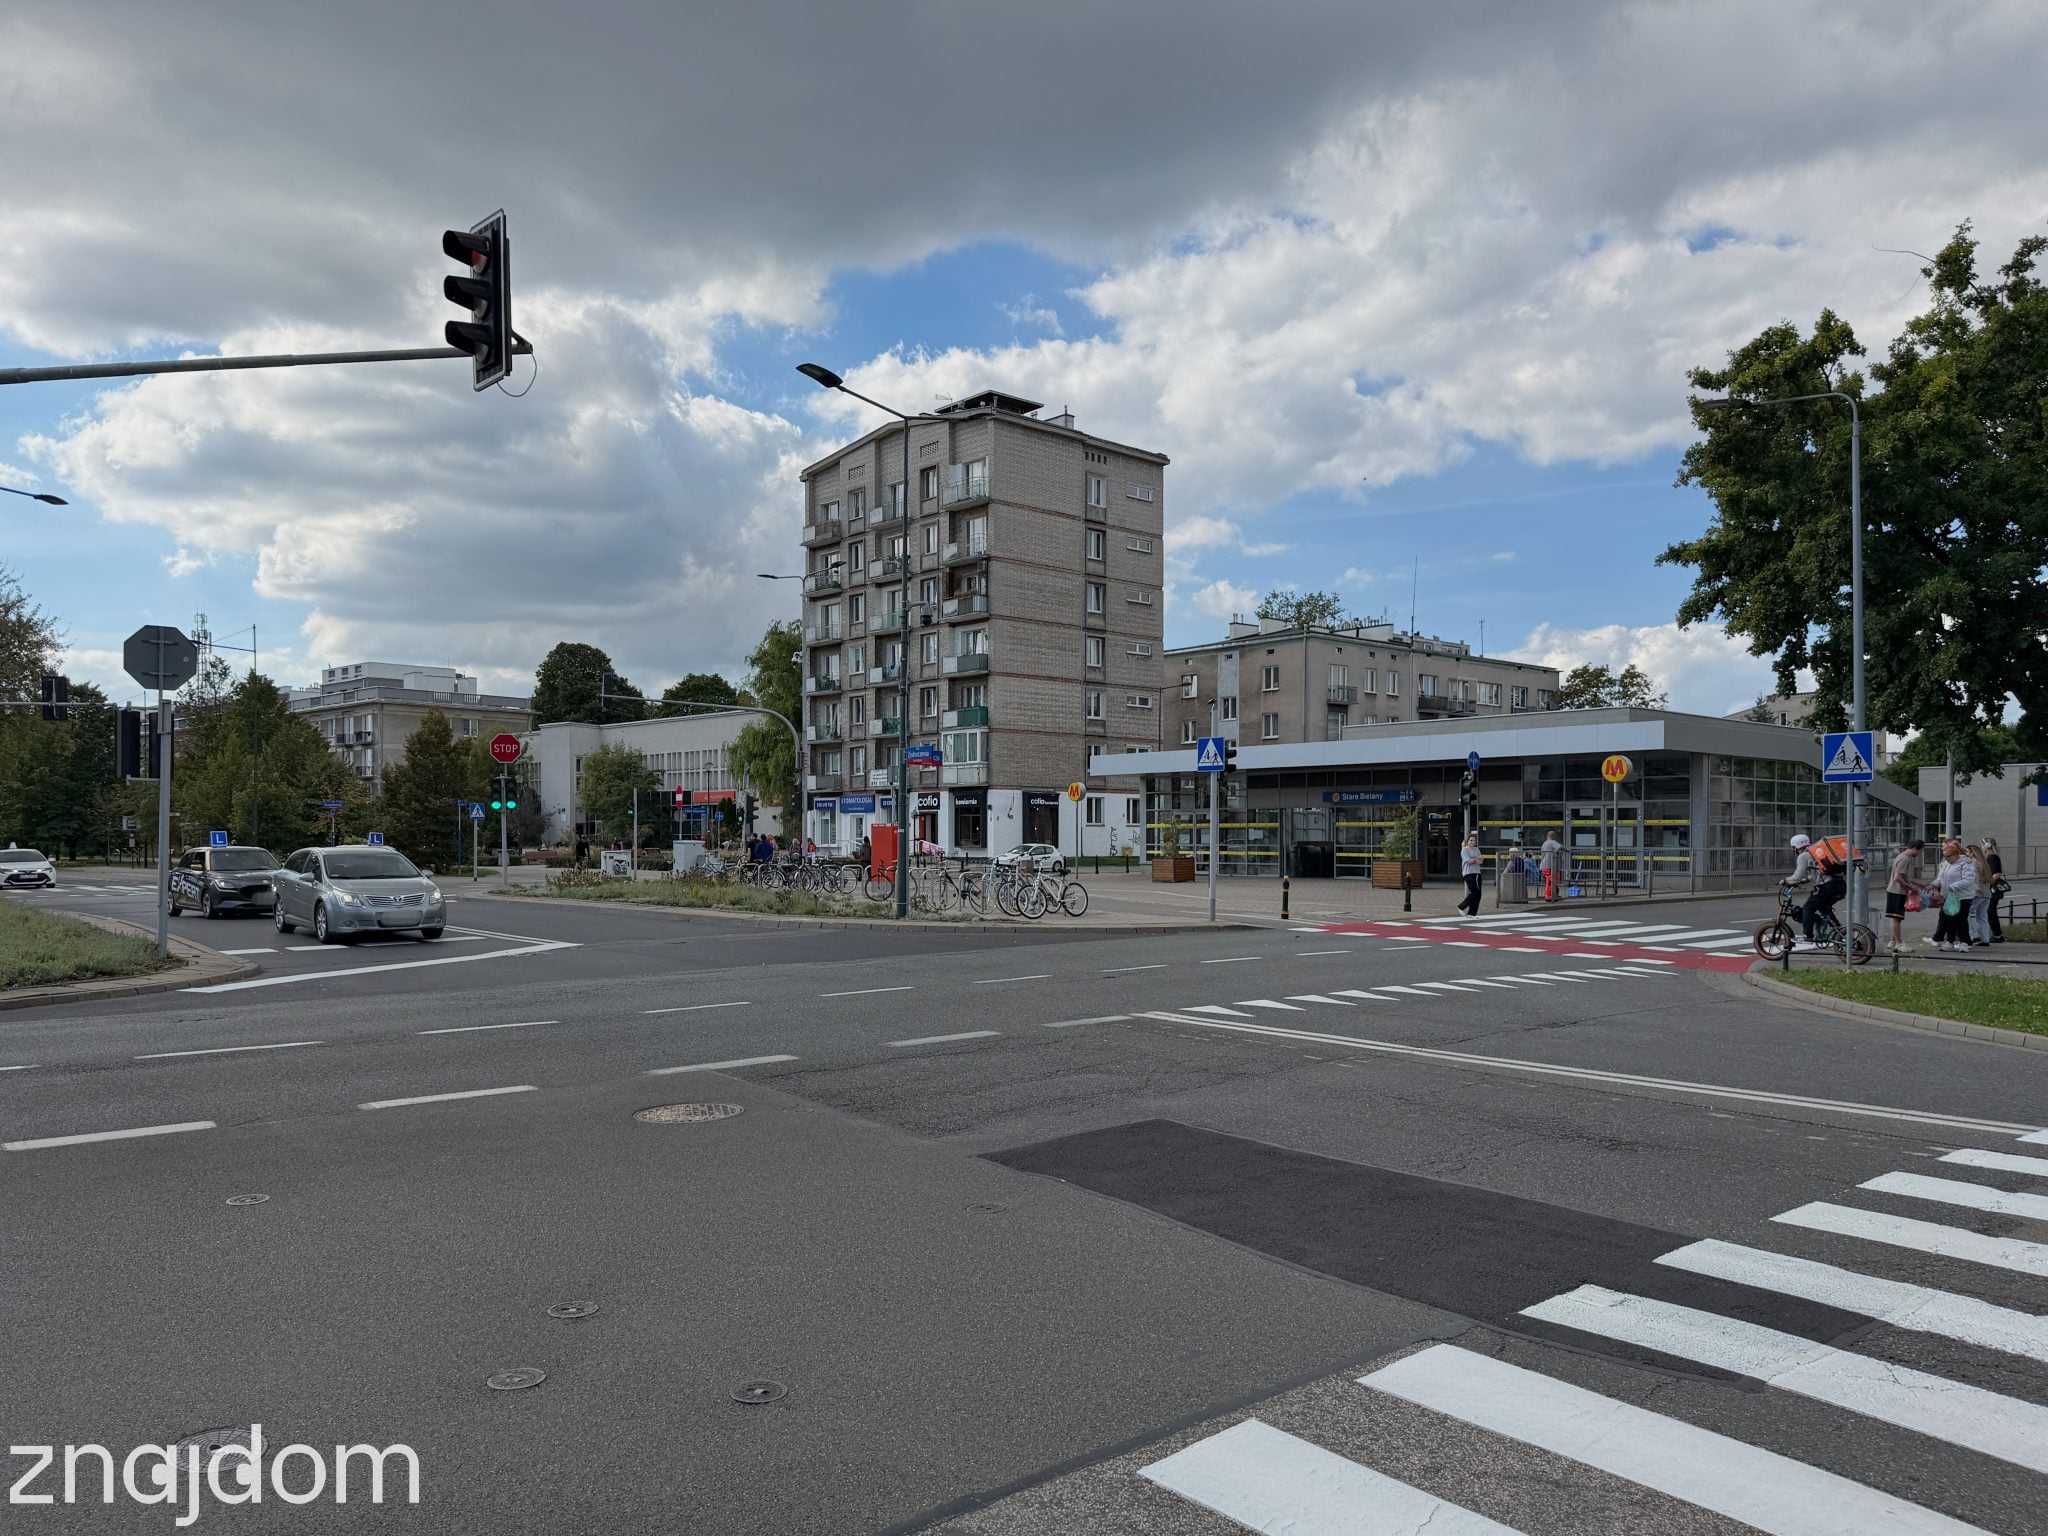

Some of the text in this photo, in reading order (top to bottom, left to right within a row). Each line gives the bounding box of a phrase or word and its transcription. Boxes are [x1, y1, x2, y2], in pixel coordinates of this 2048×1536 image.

[494, 744, 518, 752] STOP
[1605, 759, 1624, 777] M
[918, 795, 938, 807] cofio
[1342, 793, 1359, 801] Stare
[1360, 792, 1384, 801] Bielany
[216, 833, 224, 844] L
[373, 832, 381, 843] L
[171, 873, 200, 901] EXPERT
